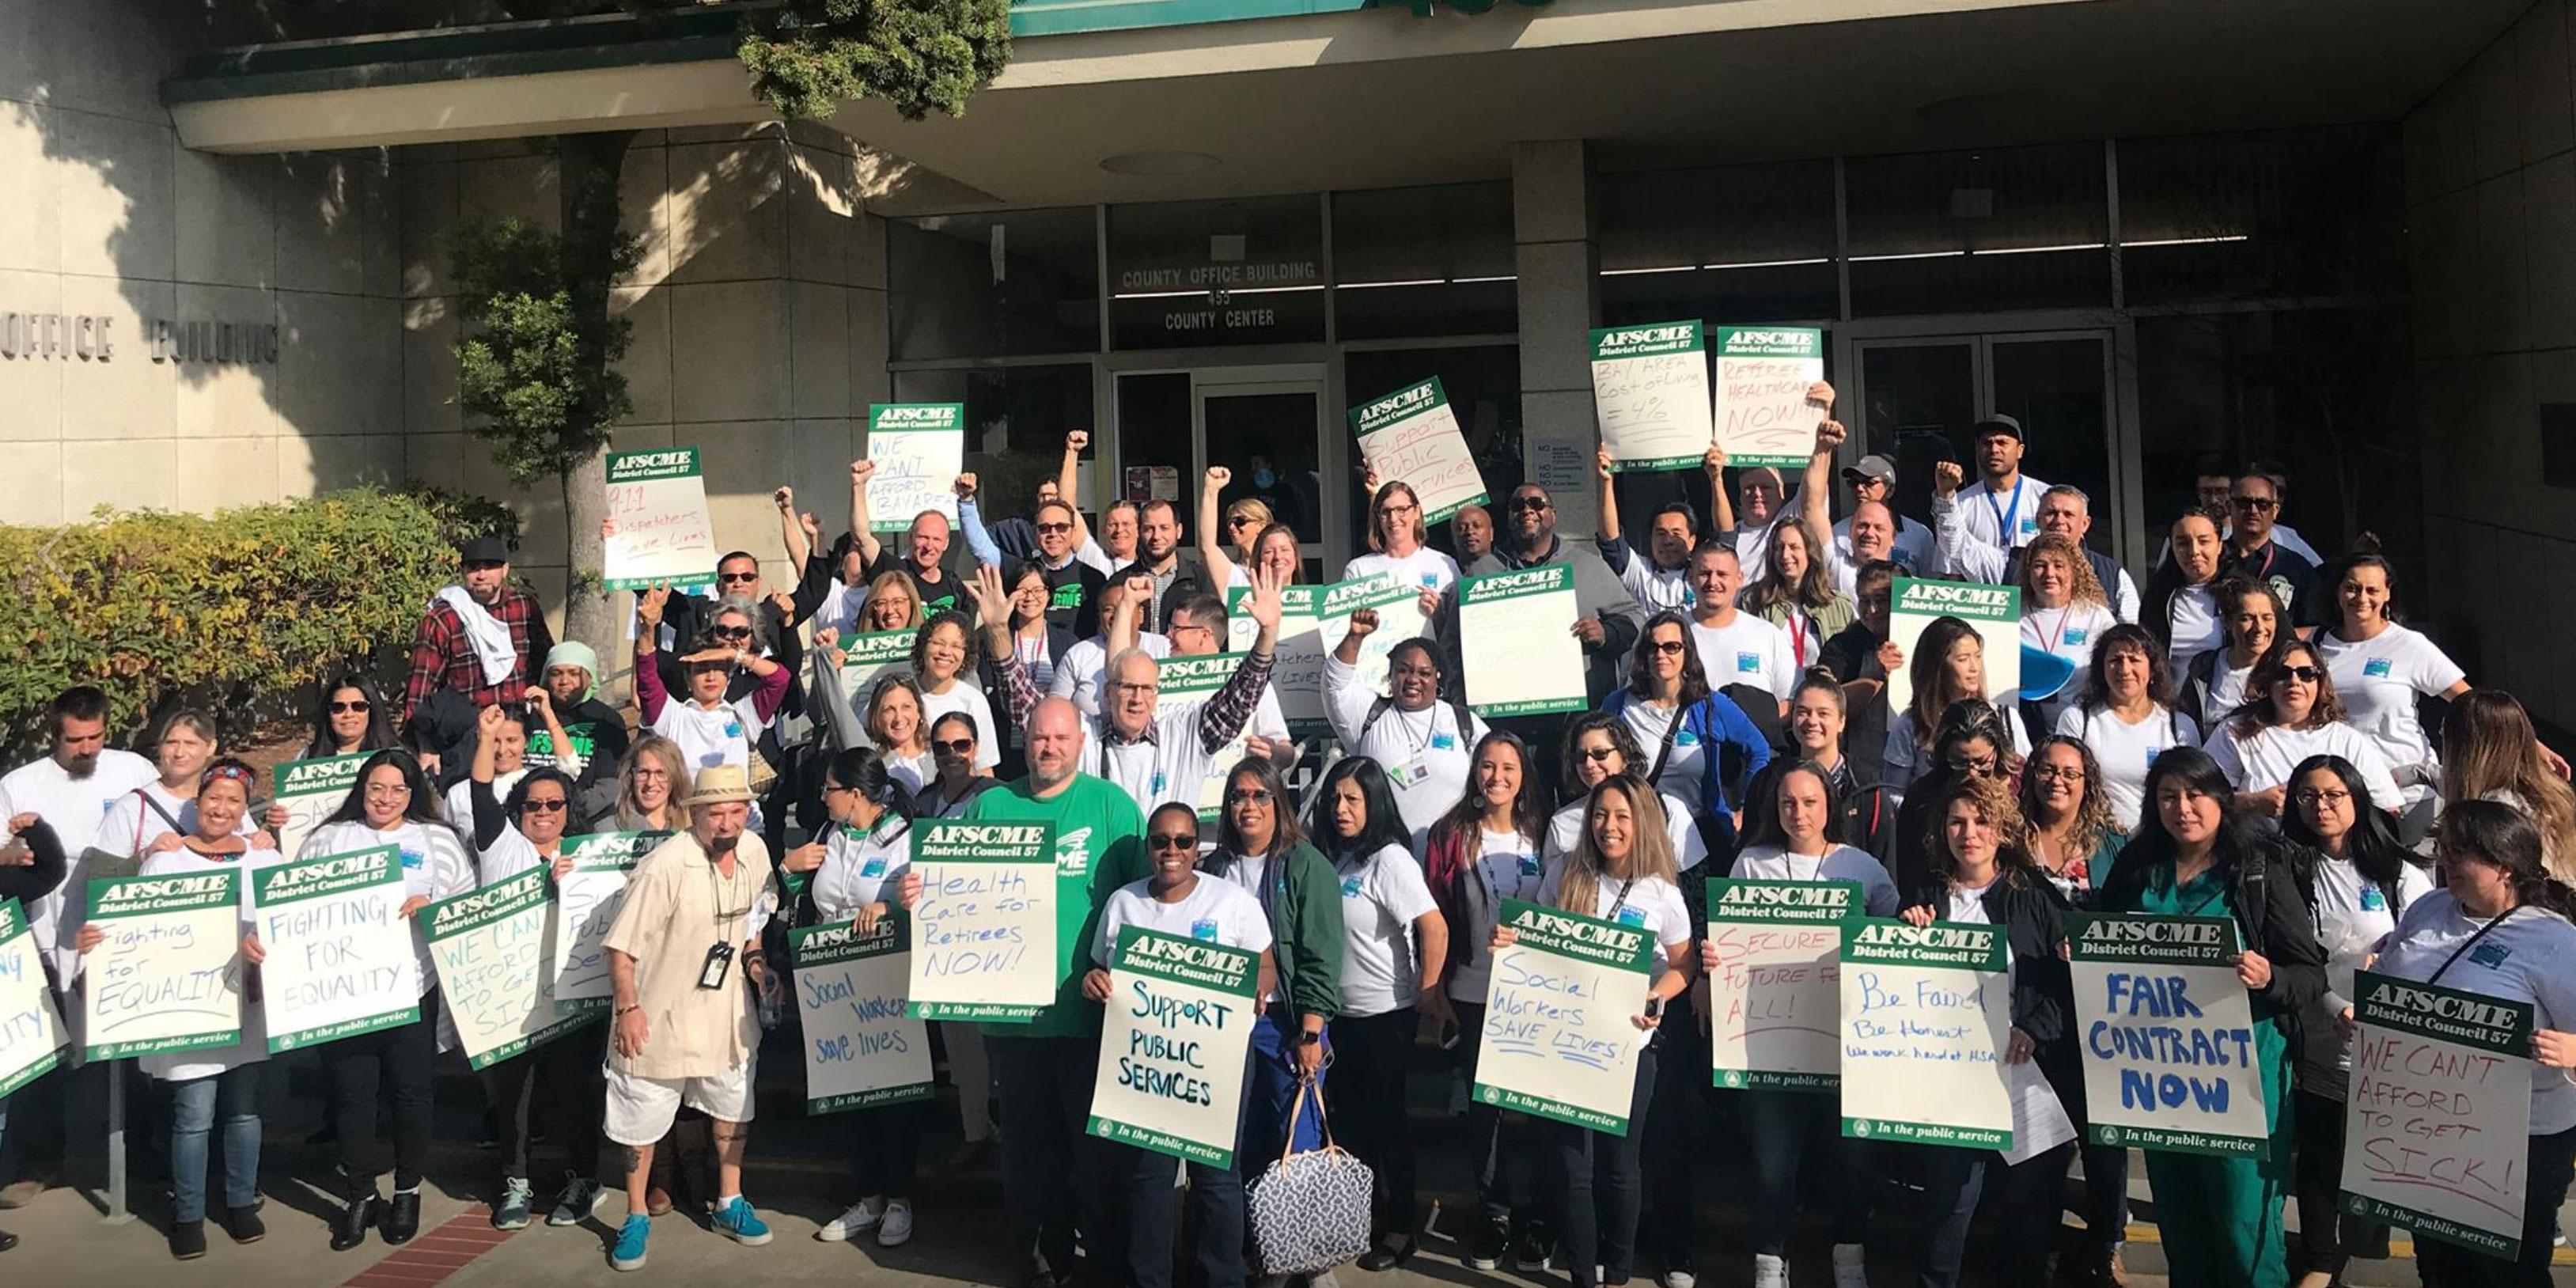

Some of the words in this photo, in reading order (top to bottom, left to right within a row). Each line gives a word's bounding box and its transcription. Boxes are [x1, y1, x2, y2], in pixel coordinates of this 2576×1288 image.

[1123, 270, 1182, 287] COUNTY
[1190, 266, 1240, 283] OFFICE
[1247, 262, 1315, 281] BUILDING
[1165, 312, 1216, 331] COUNTY
[1226, 310, 1274, 328] CENTER
[2, 315, 114, 362] OFFICE
[151, 320, 278, 364] BUILDING
[1599, 325, 1693, 347] AFSCME
[1726, 331, 1813, 344] AFSCME
[1358, 383, 1434, 424] AFSCME
[1729, 381, 1810, 402] HEALTHCAR
[877, 407, 956, 420] AFSCME
[612, 451, 691, 470] AFSCME
[1468, 568, 1563, 593] AFSCME
[1054, 593, 1082, 607] CME
[1901, 584, 2010, 606] AFSCME
[847, 633, 918, 653] AFSC
[1160, 657, 1244, 677] FSCME
[284, 757, 369, 782] AFSCM
[574, 833, 669, 856] AFSCM
[922, 826, 1044, 844] AFSCME
[922, 845, 969, 856] District
[972, 846, 1021, 857] Council
[1024, 847, 1040, 857] 57
[265, 850, 390, 890] AFSCME
[920, 868, 1027, 897] Health
[98, 874, 229, 902] AFSCME
[265, 883, 316, 901] District
[318, 873, 369, 893] Council
[371, 869, 386, 881] 57
[433, 871, 543, 925] AFSCME
[1718, 886, 1851, 907] AFSCME
[97, 900, 150, 915] District
[152, 894, 206, 910] Council
[207, 892, 226, 902] 57
[435, 915, 479, 935] District
[480, 896, 526, 921] Council
[528, 888, 543, 901] 57
[918, 899, 978, 921] Care
[1718, 906, 1770, 918] District
[1772, 908, 1827, 919] Council
[1829, 909, 1847, 919] 57
[269, 895, 388, 944] FIGHTING
[1511, 910, 1642, 951] AFSCME
[2080, 920, 2222, 945] AFSCME
[800, 945, 843, 962] District
[844, 941, 881, 956] Council
[882, 938, 896, 948] 57
[924, 927, 1023, 947] Retirees
[1718, 927, 1834, 960] SECURE
[1853, 925, 1994, 950] AFSCME
[2081, 942, 2137, 956] District
[2139, 945, 2199, 957] Council
[2201, 948, 2221, 959] 57
[305, 934, 363, 972] FOR
[924, 945, 1027, 977] NOW!
[1126, 935, 1249, 975] AFSCME
[1562, 940, 1616, 960] Council
[1616, 952, 1635, 964] 57
[1852, 945, 1909, 959] District
[1911, 949, 1970, 962] Council
[1972, 953, 1989, 964] 57
[1123, 954, 1172, 973] District
[1173, 965, 1224, 984] Council
[1225, 975, 1242, 987] 57
[1499, 951, 1601, 1001] Social
[1724, 962, 1807, 991] FUTURE
[284, 965, 402, 1013] EQUALITY
[457, 989, 491, 1014] TO
[1858, 972, 1907, 1013] Be
[2106, 973, 2203, 1018] FAIR
[1131, 980, 1233, 1029] SUPPORT
[1494, 987, 1585, 1027] Workers
[1727, 995, 1795, 1025] ALL!
[2366, 983, 2518, 1032] AFSCME
[1853, 1019, 1893, 1039] Be
[2366, 1004, 2423, 1027] District
[2425, 1017, 2487, 1041] Council
[2490, 1031, 2513, 1046] 57
[1131, 1029, 1204, 1070] PUBLIC
[1484, 1015, 1546, 1040] SAVE
[1552, 1029, 1630, 1065] LIVES!
[2089, 1021, 2252, 1068] CONTRACT
[2360, 1031, 2403, 1074] WE
[2405, 1044, 2506, 1084] CAN'T
[1118, 1056, 1211, 1107] SERVICES
[2120, 1068, 2229, 1113] NOW
[2356, 1076, 2472, 1116] AFFORD
[1877, 1123, 1891, 1135] In
[1895, 1124, 1914, 1135] the
[1916, 1124, 1956, 1139] public
[1958, 1129, 2002, 1143] service
[2360, 1109, 2392, 1130] TO
[2404, 1119, 2483, 1140] GET
[2125, 1129, 2139, 1140] In
[2142, 1131, 2163, 1143] the
[2166, 1134, 2207, 1148] public
[2210, 1138, 2256, 1152] service
